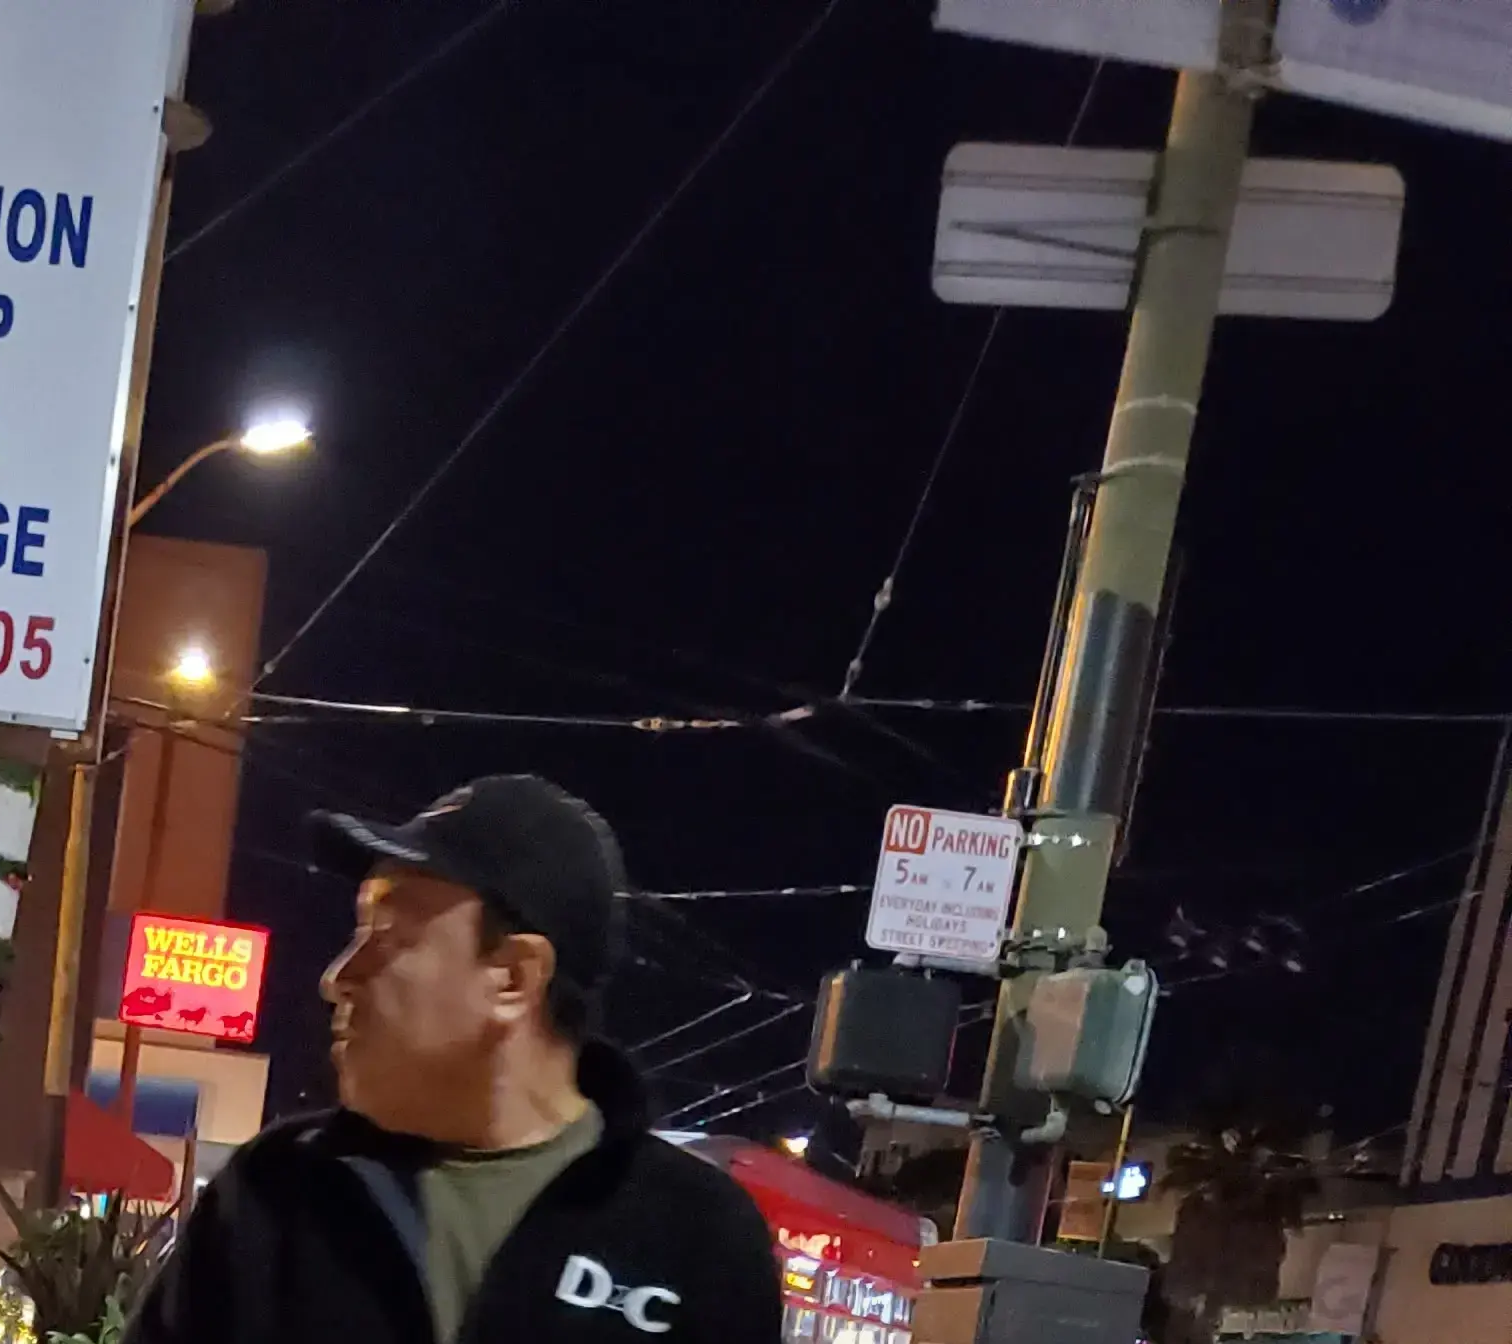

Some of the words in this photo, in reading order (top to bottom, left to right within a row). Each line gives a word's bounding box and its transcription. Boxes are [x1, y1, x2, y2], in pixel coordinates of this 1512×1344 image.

[889, 812, 925, 850] NO
[931, 826, 1011, 860] PARKING
[143, 924, 253, 964] WELLS
[140, 953, 248, 990] FARGO
